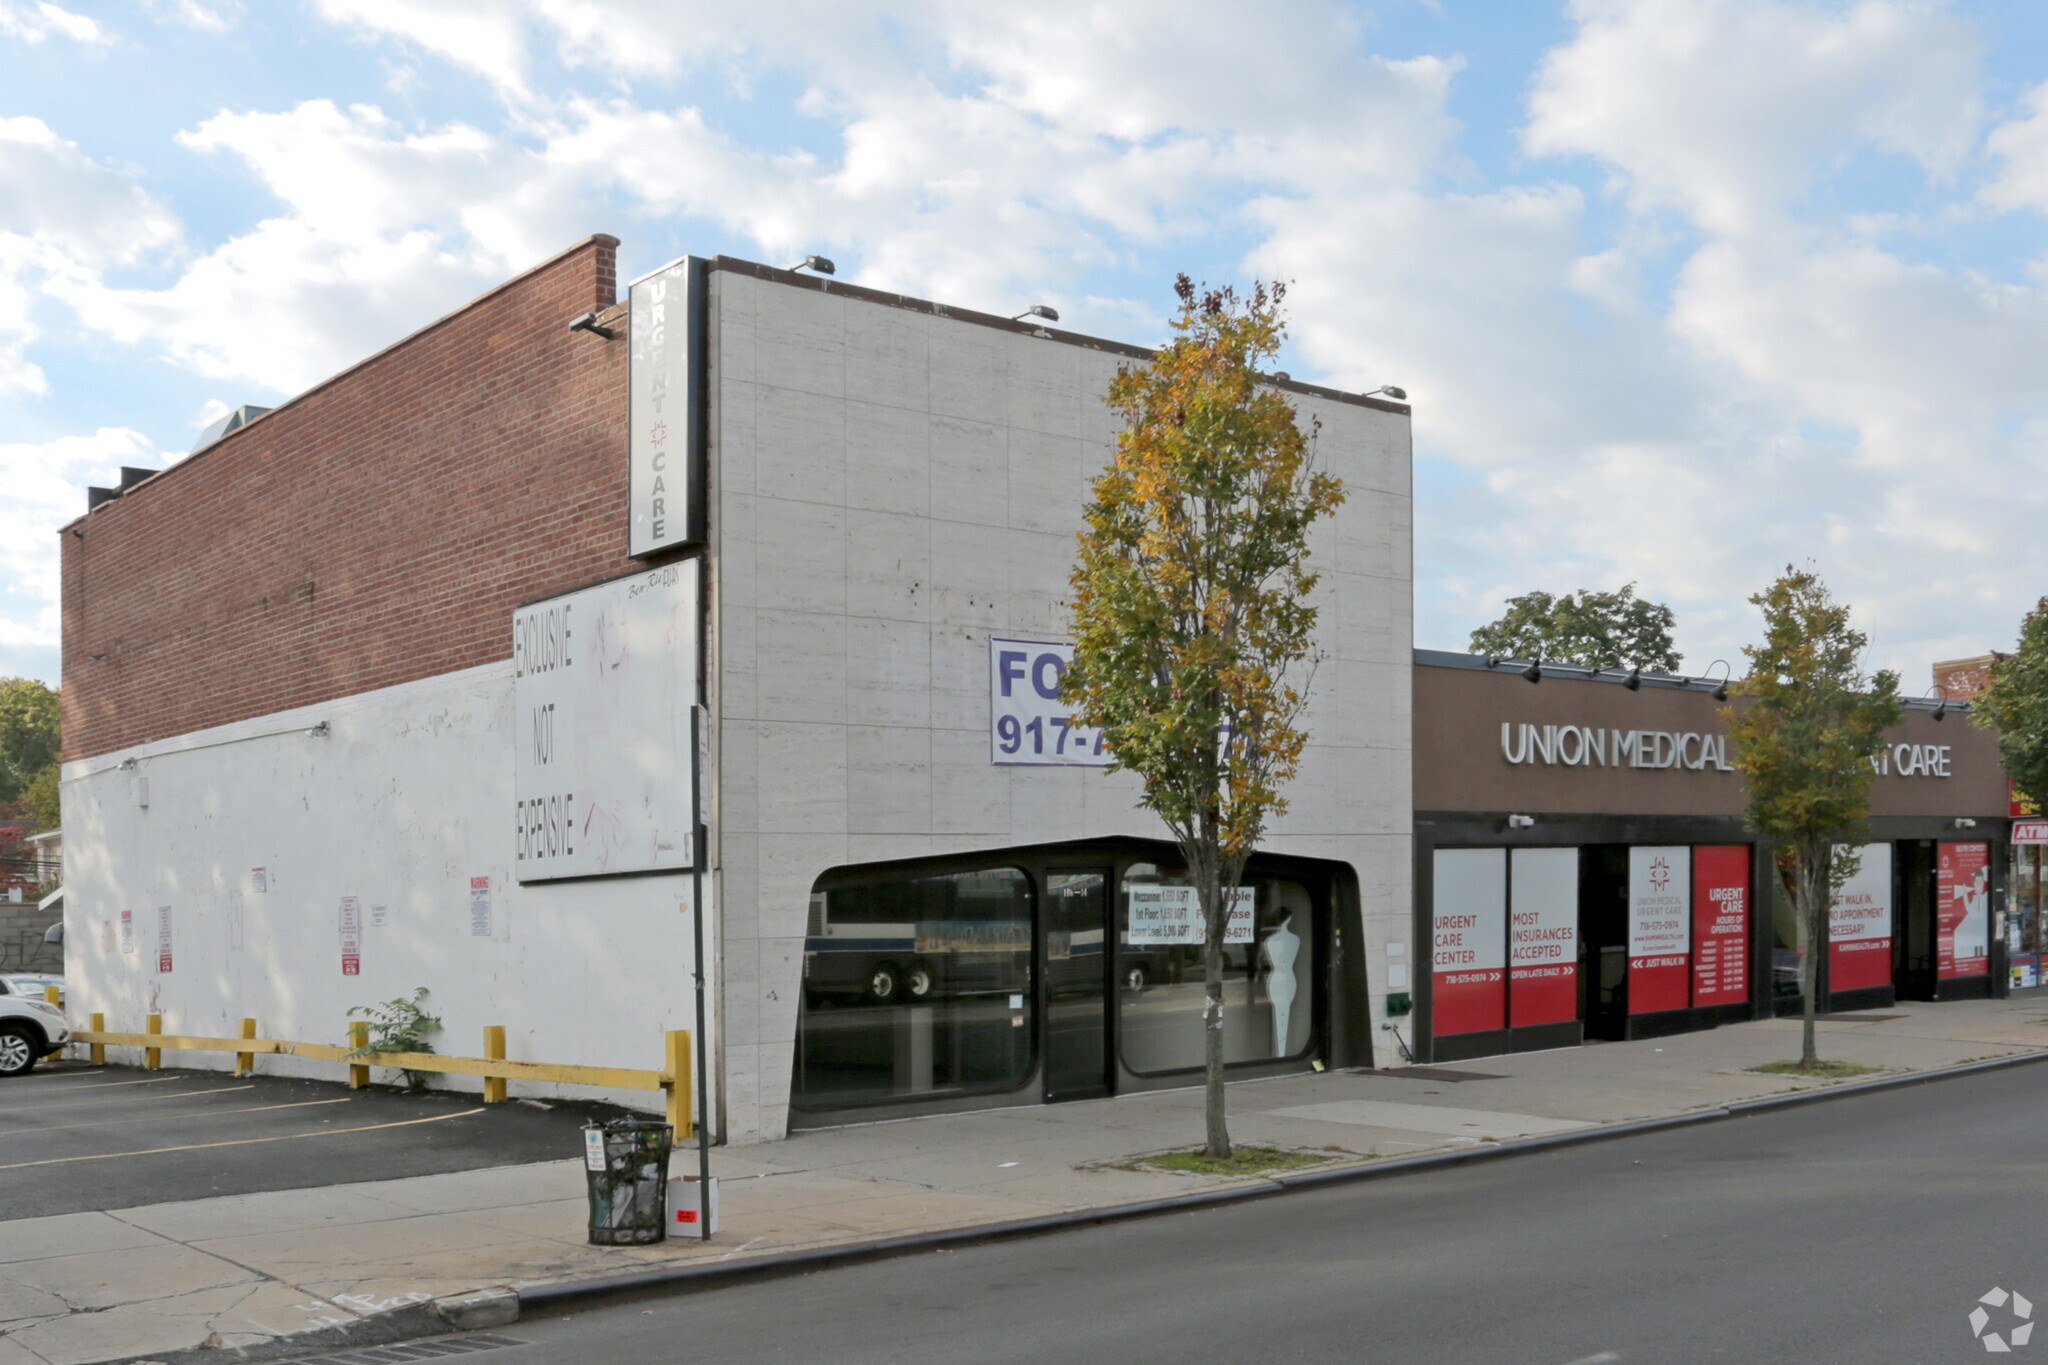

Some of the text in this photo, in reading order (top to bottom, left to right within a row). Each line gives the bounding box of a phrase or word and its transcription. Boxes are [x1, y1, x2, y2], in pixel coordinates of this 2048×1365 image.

[651, 279, 666, 541] URGENT CARE
[516, 605, 572, 678] EXCLUSIVE
[999, 651, 1070, 700] FO
[533, 703, 555, 766] NOT
[1501, 722, 1605, 767] UNION
[1611, 729, 1735, 772] MEDICAL
[1893, 743, 1952, 777] CARE
[517, 793, 573, 861] EXPENSIVE
[2015, 825, 2048, 839] ATM
[1709, 888, 1744, 901] URGENT
[1637, 906, 1682, 916] URGENT CARE
[1721, 900, 1744, 913] CARE
[1840, 907, 1884, 919] APPOINTMENT
[1434, 915, 1477, 929] URGENT
[1513, 912, 1539, 925] MOST
[1512, 927, 1573, 943] INSURANCES
[1829, 924, 1865, 936] NECESSARY
[1434, 933, 1463, 947] CARE
[1434, 950, 1476, 965] CENTER
[1512, 944, 1562, 960] ACCEPTED
[1511, 967, 1560, 979] OPEN LATE DAILY
